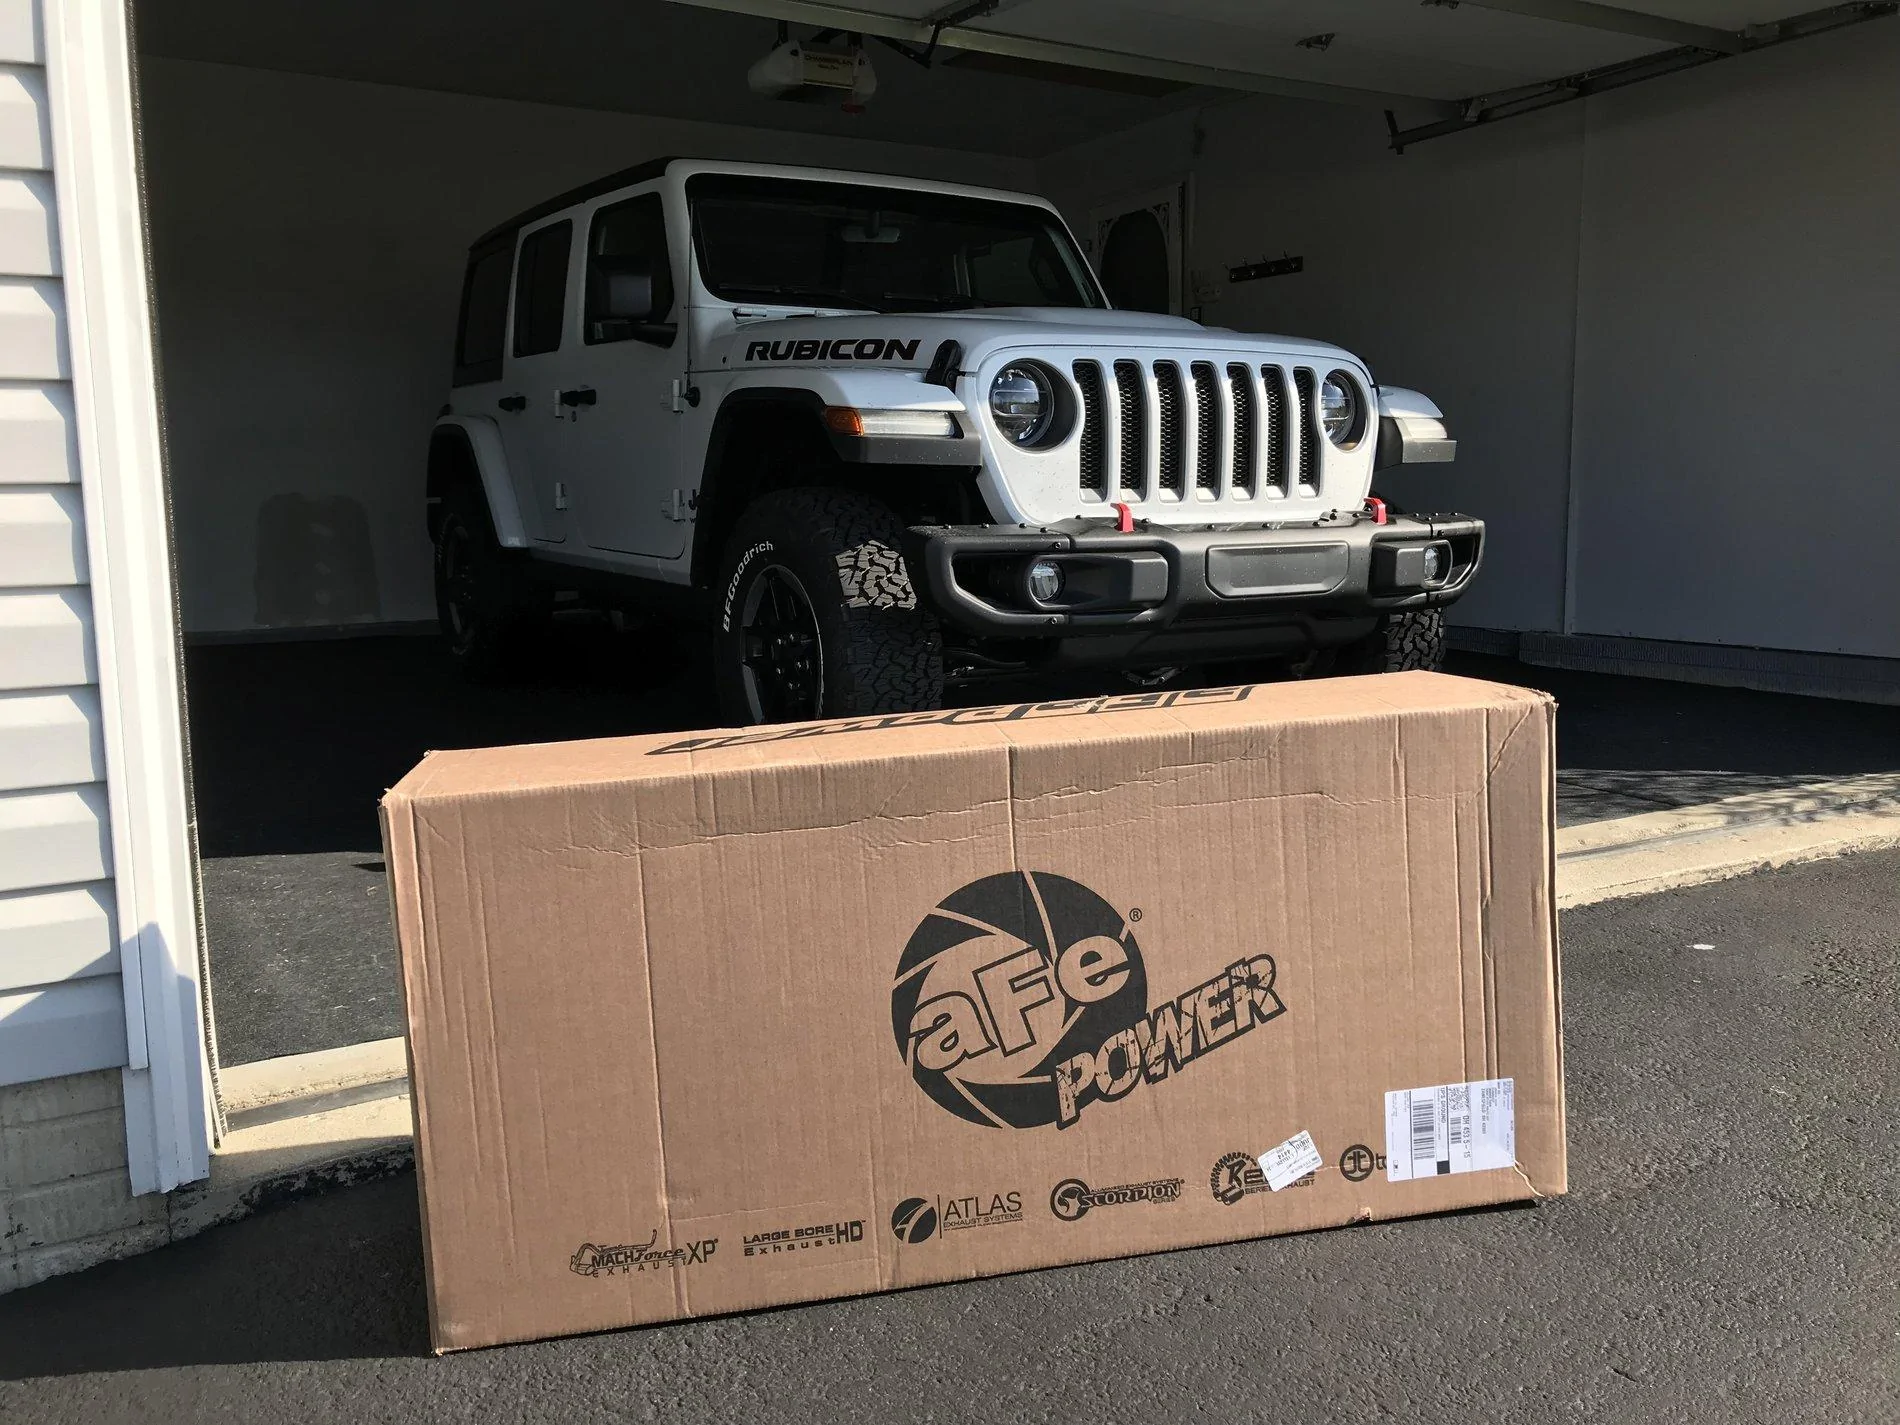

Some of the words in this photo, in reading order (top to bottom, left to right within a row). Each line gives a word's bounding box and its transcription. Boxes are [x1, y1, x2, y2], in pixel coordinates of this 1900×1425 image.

[745, 339, 921, 361] RUBICON
[723, 541, 774, 632] BFGoodrich
[1055, 953, 1287, 1130] POWER
[944, 1191, 1022, 1220] ATLAS
[1080, 1181, 1182, 1208] SCORPION
[743, 1230, 790, 1245] LARGE
[794, 1224, 834, 1239] BORE
[835, 1220, 863, 1245] HD
[943, 1217, 982, 1229] EXHAUST
[983, 1211, 1023, 1223] SYSTEMS
[744, 1236, 836, 1257] Exhaust
